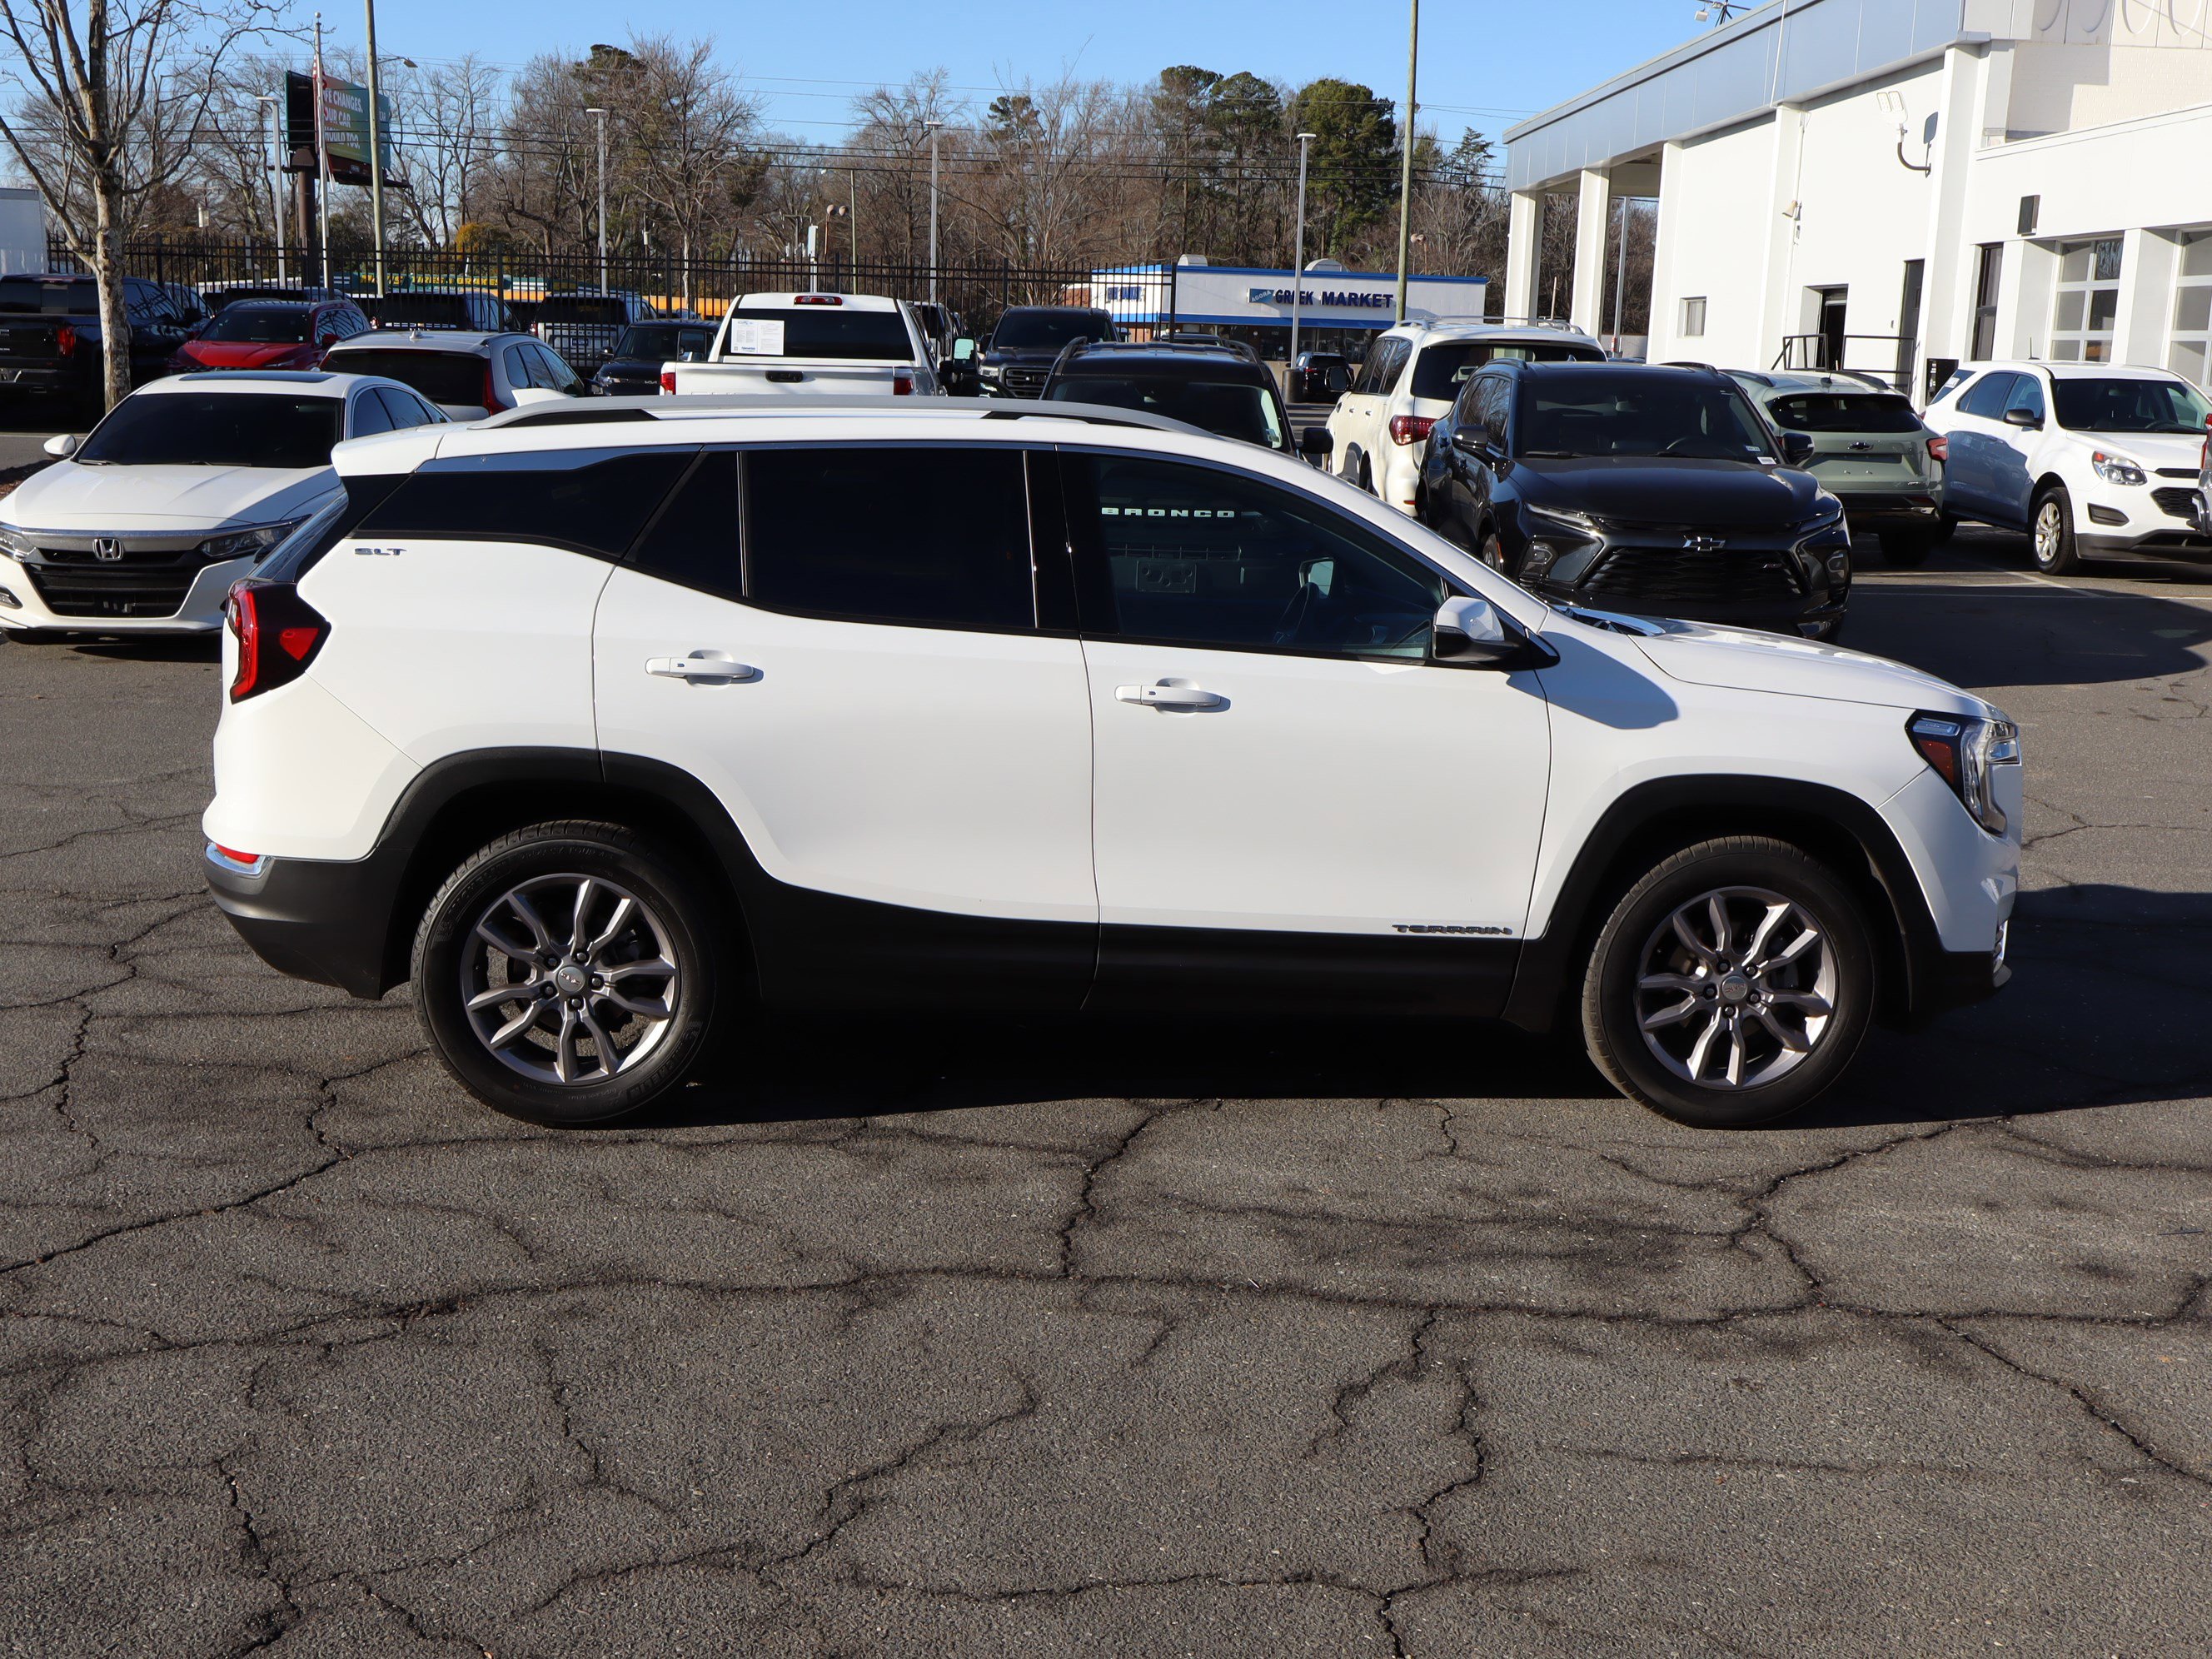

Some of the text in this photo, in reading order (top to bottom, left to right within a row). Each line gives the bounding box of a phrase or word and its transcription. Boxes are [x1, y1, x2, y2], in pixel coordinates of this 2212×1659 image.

[333, 90, 363, 113] CHANGES.
[324, 106, 351, 127] OUR CAR
[325, 126, 346, 145] HOULD
[1251, 290, 1272, 302] AGORA
[1321, 291, 1394, 308] MARKET
[1101, 507, 1235, 518] BRONCO
[354, 547, 407, 556] SLT
[1392, 924, 1513, 935] TERRAIN
